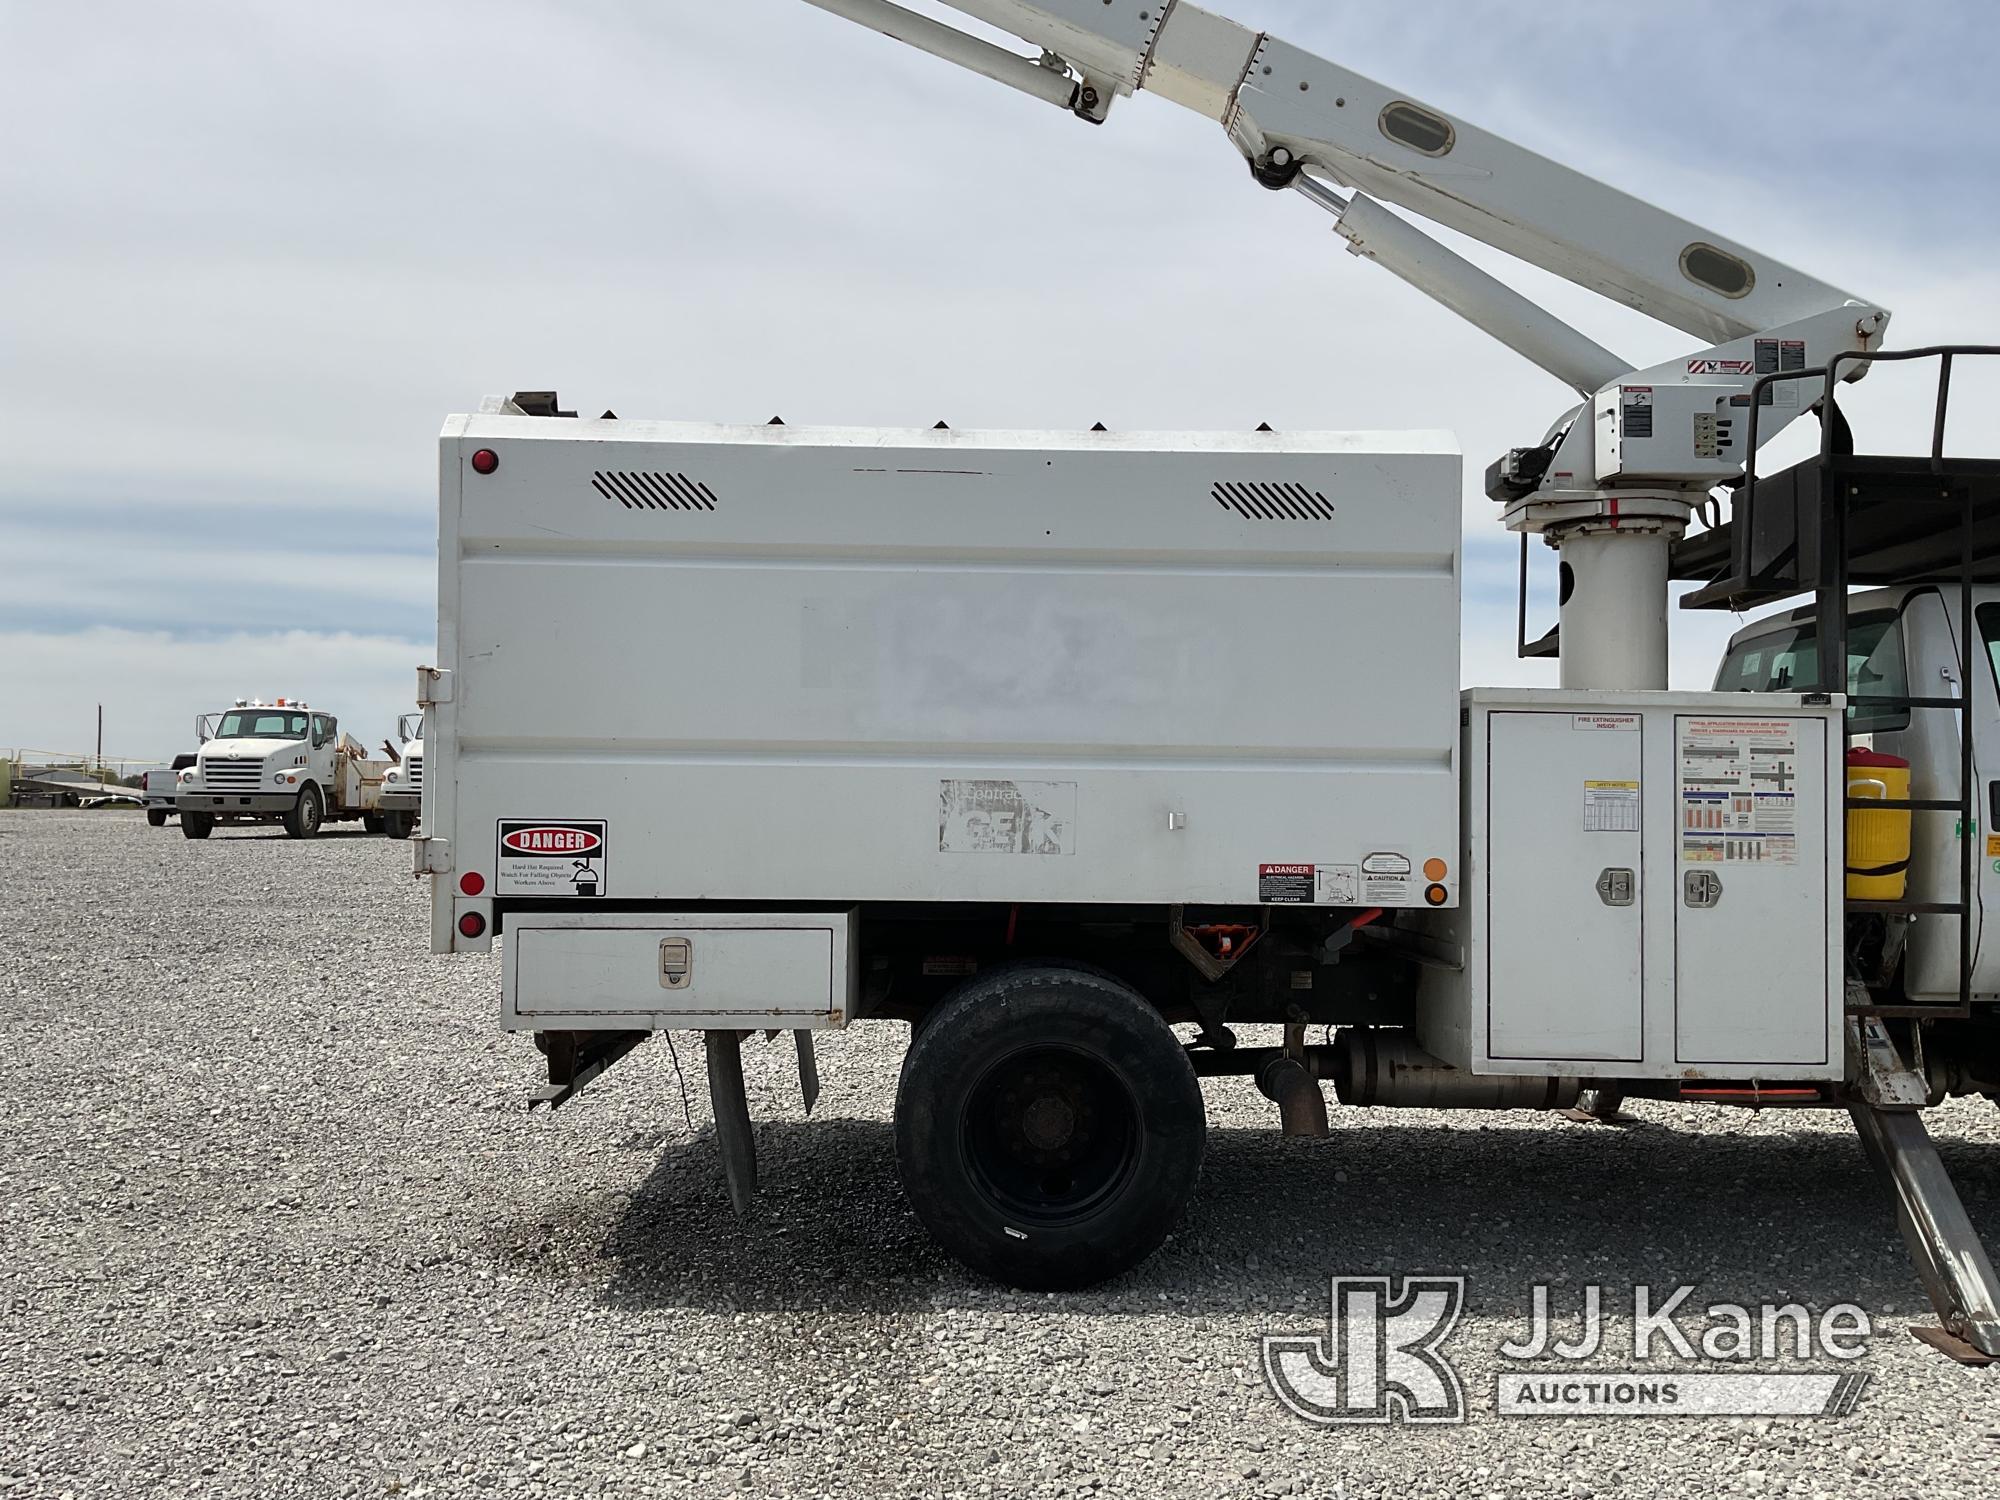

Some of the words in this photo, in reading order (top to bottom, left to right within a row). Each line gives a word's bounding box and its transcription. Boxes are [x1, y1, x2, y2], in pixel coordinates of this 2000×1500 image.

[520, 832, 585, 848] DANGER
[538, 864, 564, 872] Required
[1274, 865, 1309, 874] DANGER
[530, 872, 550, 880] Falling
[550, 872, 572, 880] Objects
